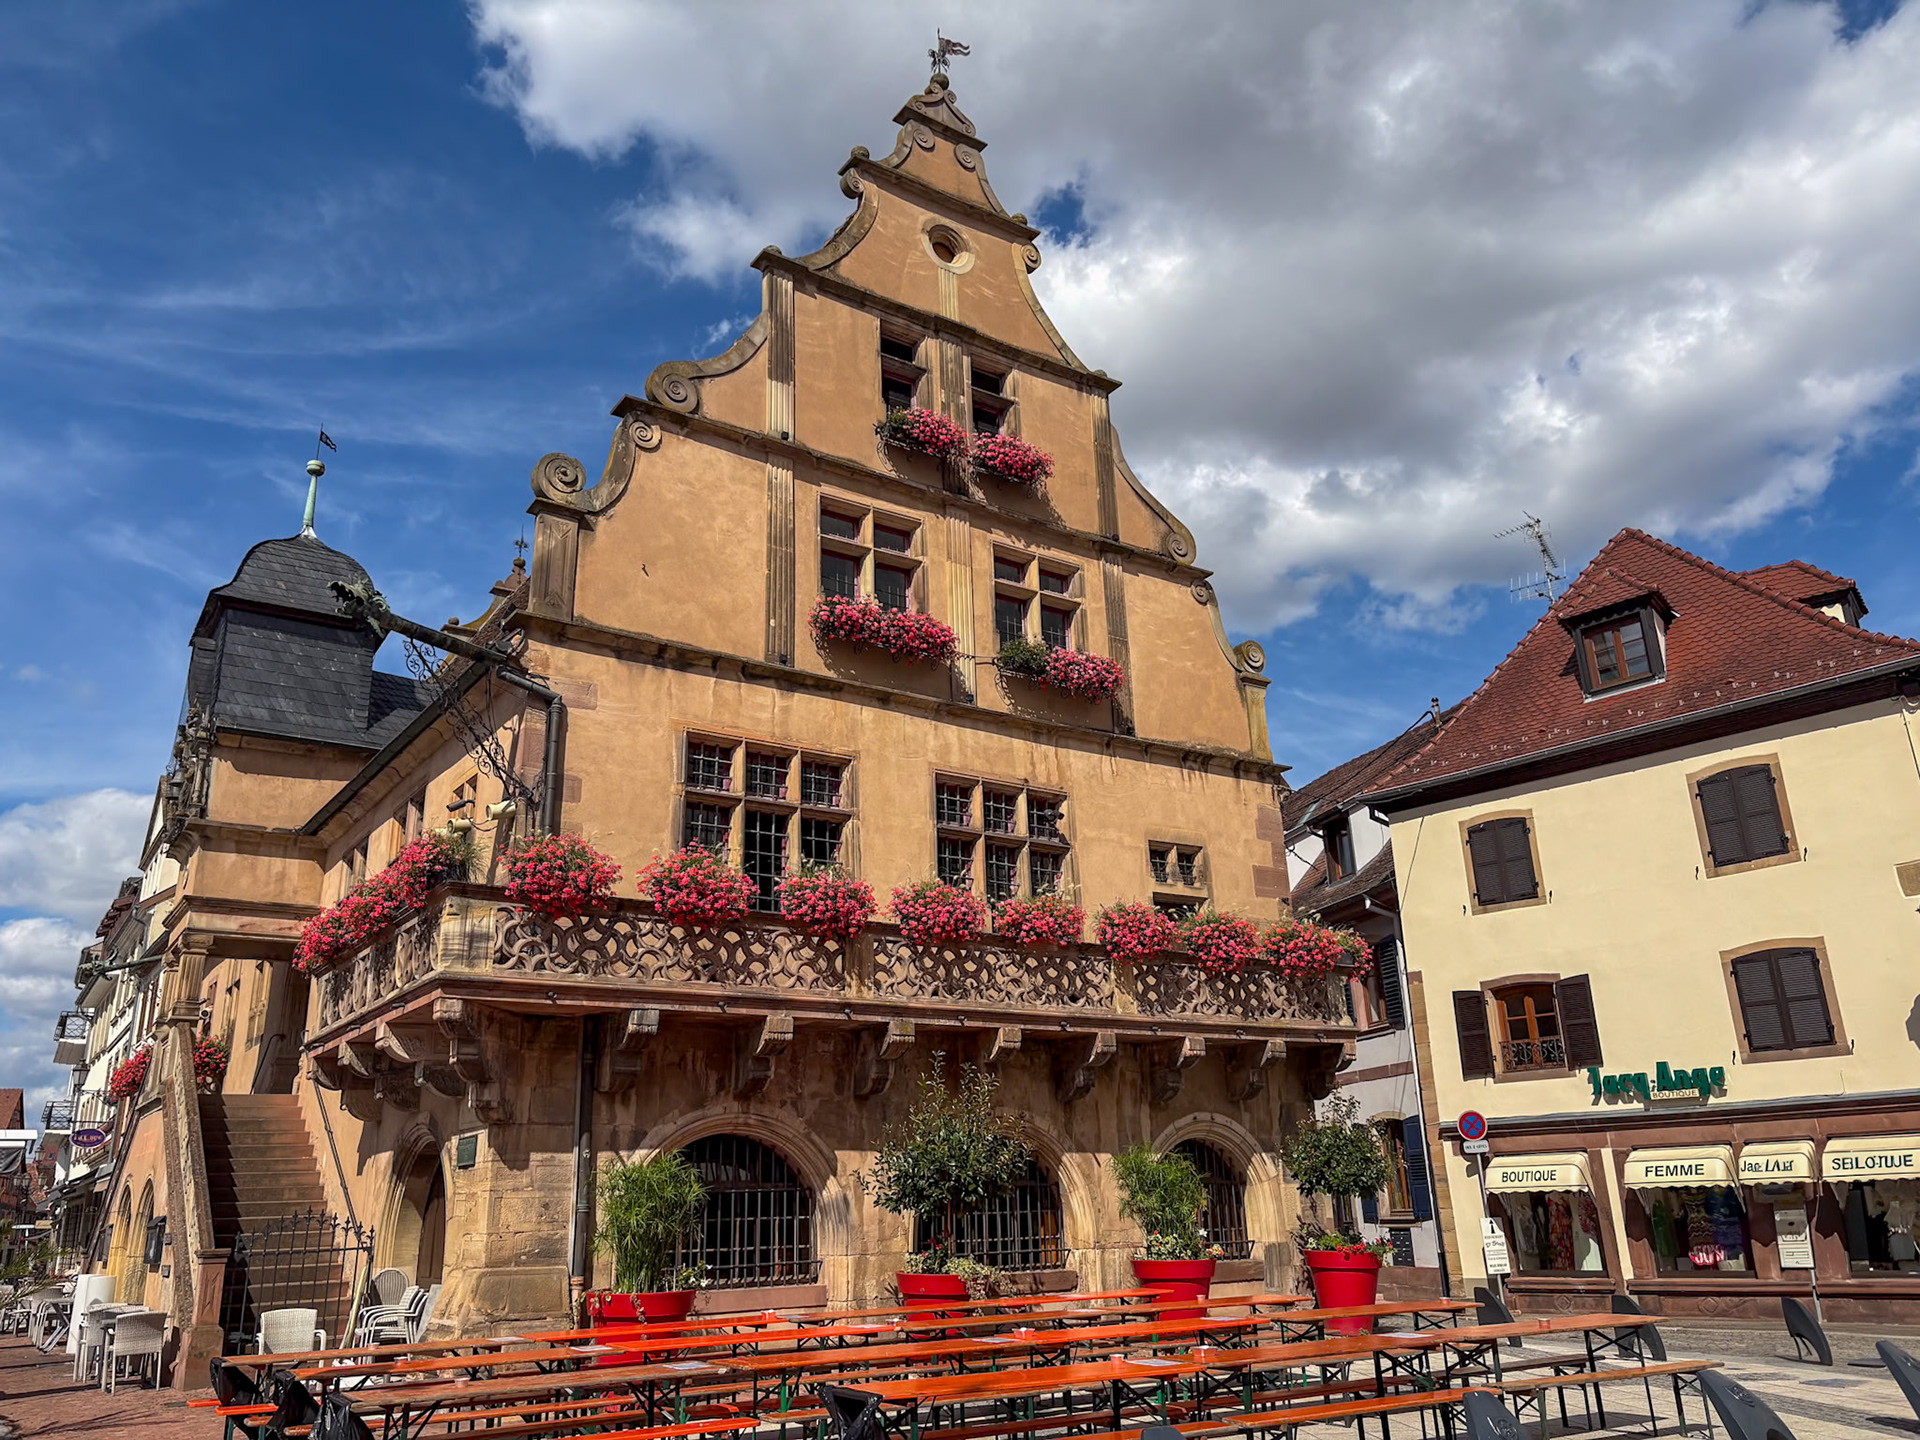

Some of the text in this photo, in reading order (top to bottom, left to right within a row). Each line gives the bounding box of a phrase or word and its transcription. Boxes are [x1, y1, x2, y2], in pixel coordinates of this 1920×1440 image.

[1652, 1089, 1698, 1099] BOUTIQUE
[1501, 1170, 1557, 1182] BOUTIQUE
[1645, 1164, 1705, 1177] FEMME
